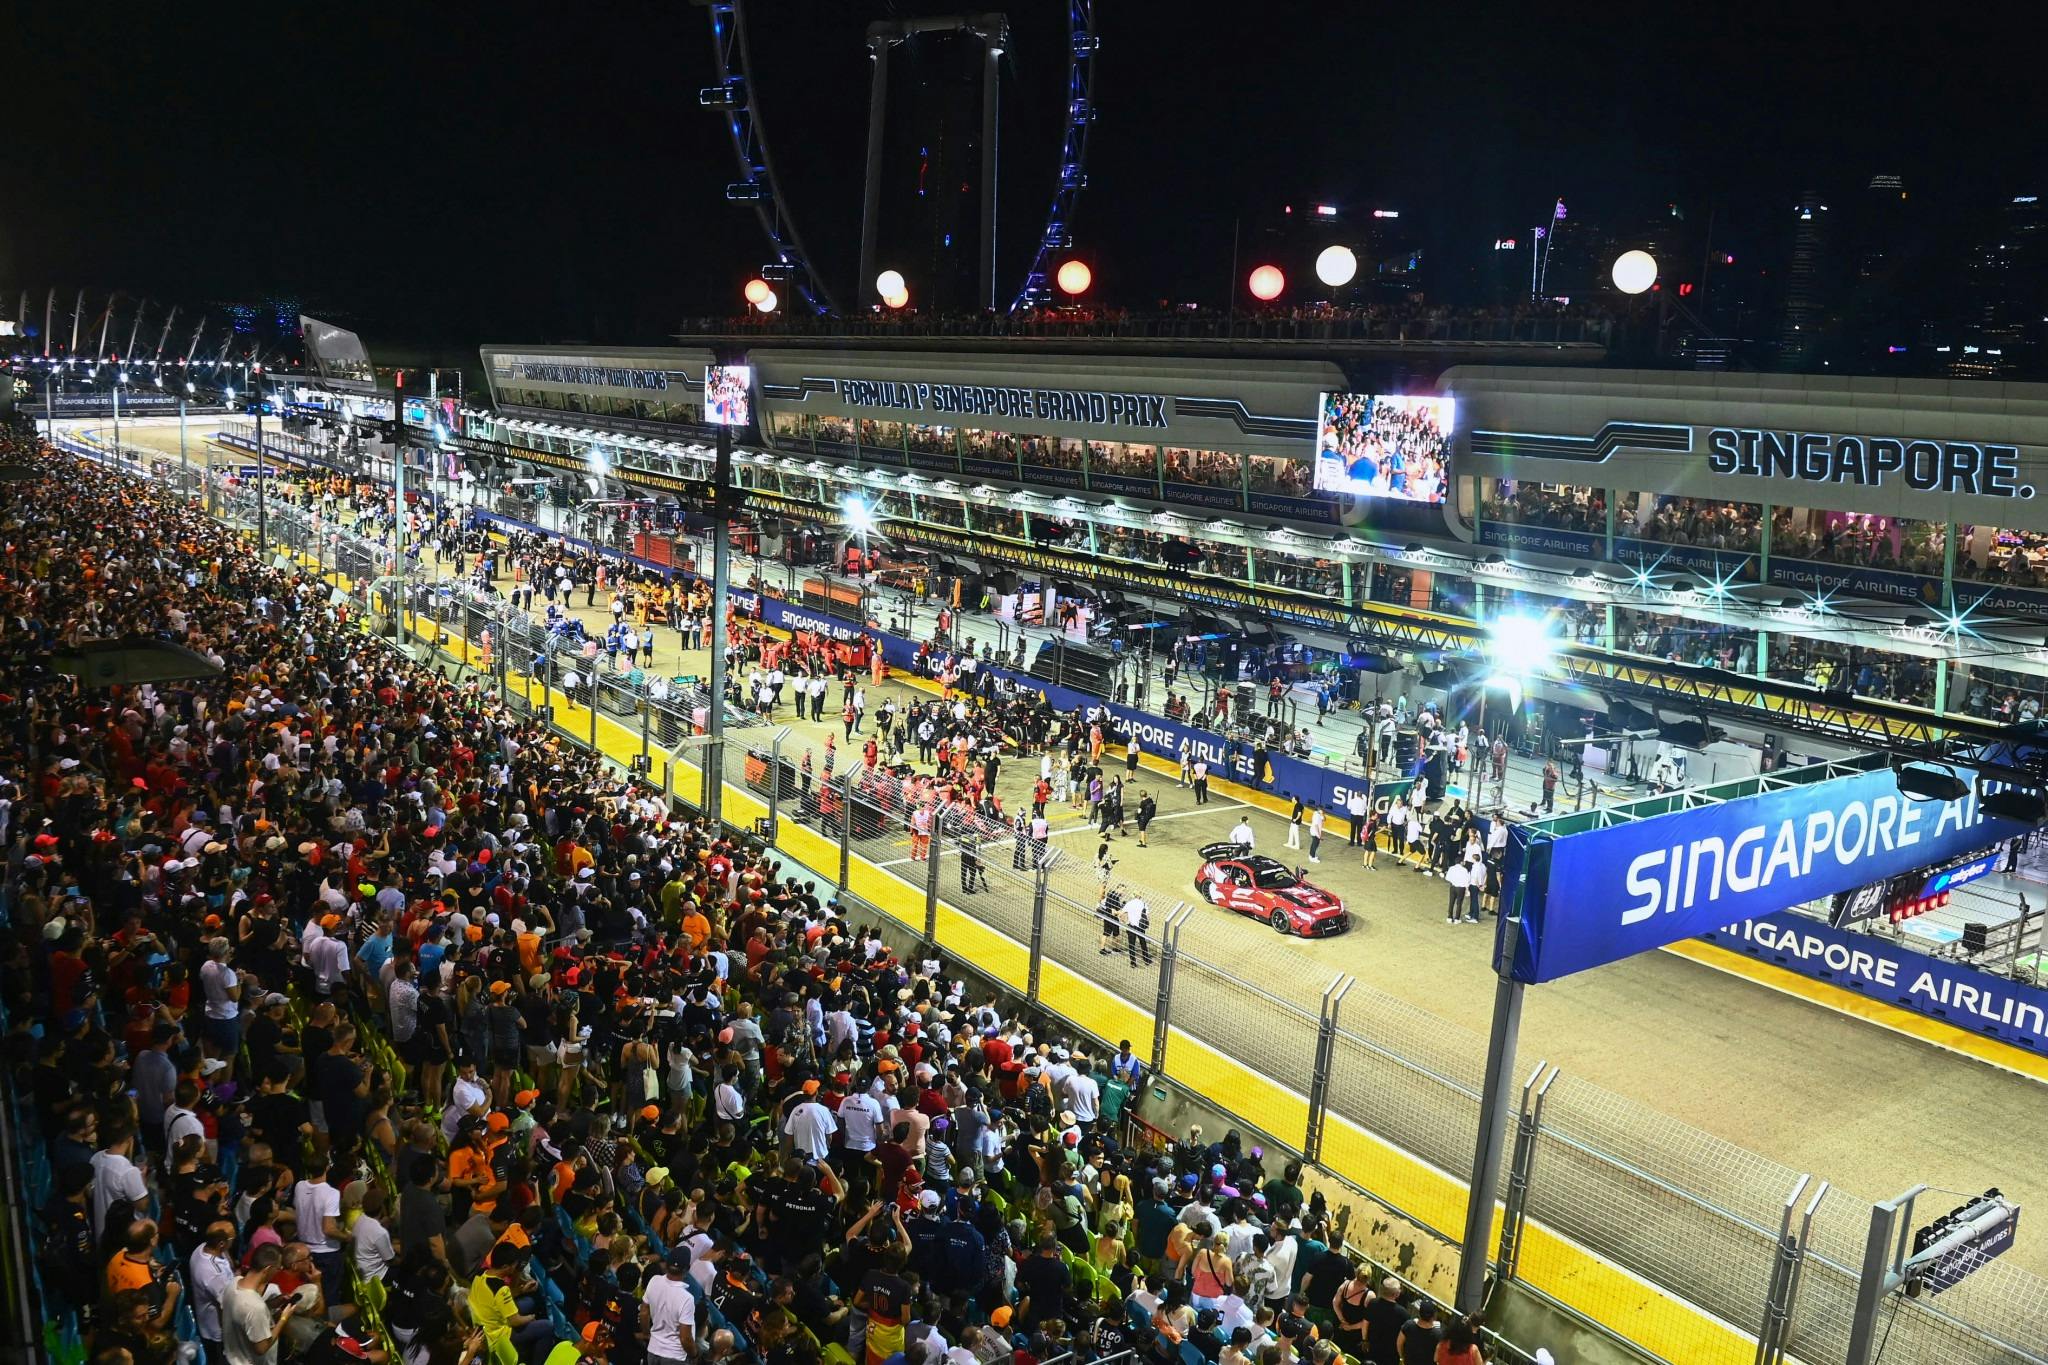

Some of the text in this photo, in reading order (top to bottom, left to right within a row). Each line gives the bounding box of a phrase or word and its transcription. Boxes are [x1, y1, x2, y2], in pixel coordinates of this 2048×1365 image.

[841, 379, 913, 410] FORMULA
[931, 384, 1035, 419] SINGAPORE
[1035, 389, 1107, 425] GRAND
[1108, 393, 1168, 429] PRIX
[1091, 481, 1123, 492] SINGAPORE
[1166, 490, 1235, 507] SINGAPORE AIRLINES
[1251, 501, 1329, 518] SINGAPORE AIRLINES
[1484, 530, 1590, 554] SINGAPORE AIRLINES
[1618, 549, 1741, 574] SINGAPORE AIRLINES
[1774, 568, 1917, 598] SINGAPORE AIRLINES
[1958, 594, 2048, 616] SINGAPORE
[782, 610, 831, 638] SINGAPORE
[1179, 737, 1256, 776] AIRLIES
[1620, 795, 1922, 927] SINGAPORE
[1852, 885, 1882, 912] FIA
[845, 1105, 870, 1113] PETRONAS
[785, 1202, 816, 1212] PETRONAS
[1979, 1227, 2008, 1253] AIRLINES
[873, 1285, 891, 1297] SPAIN
